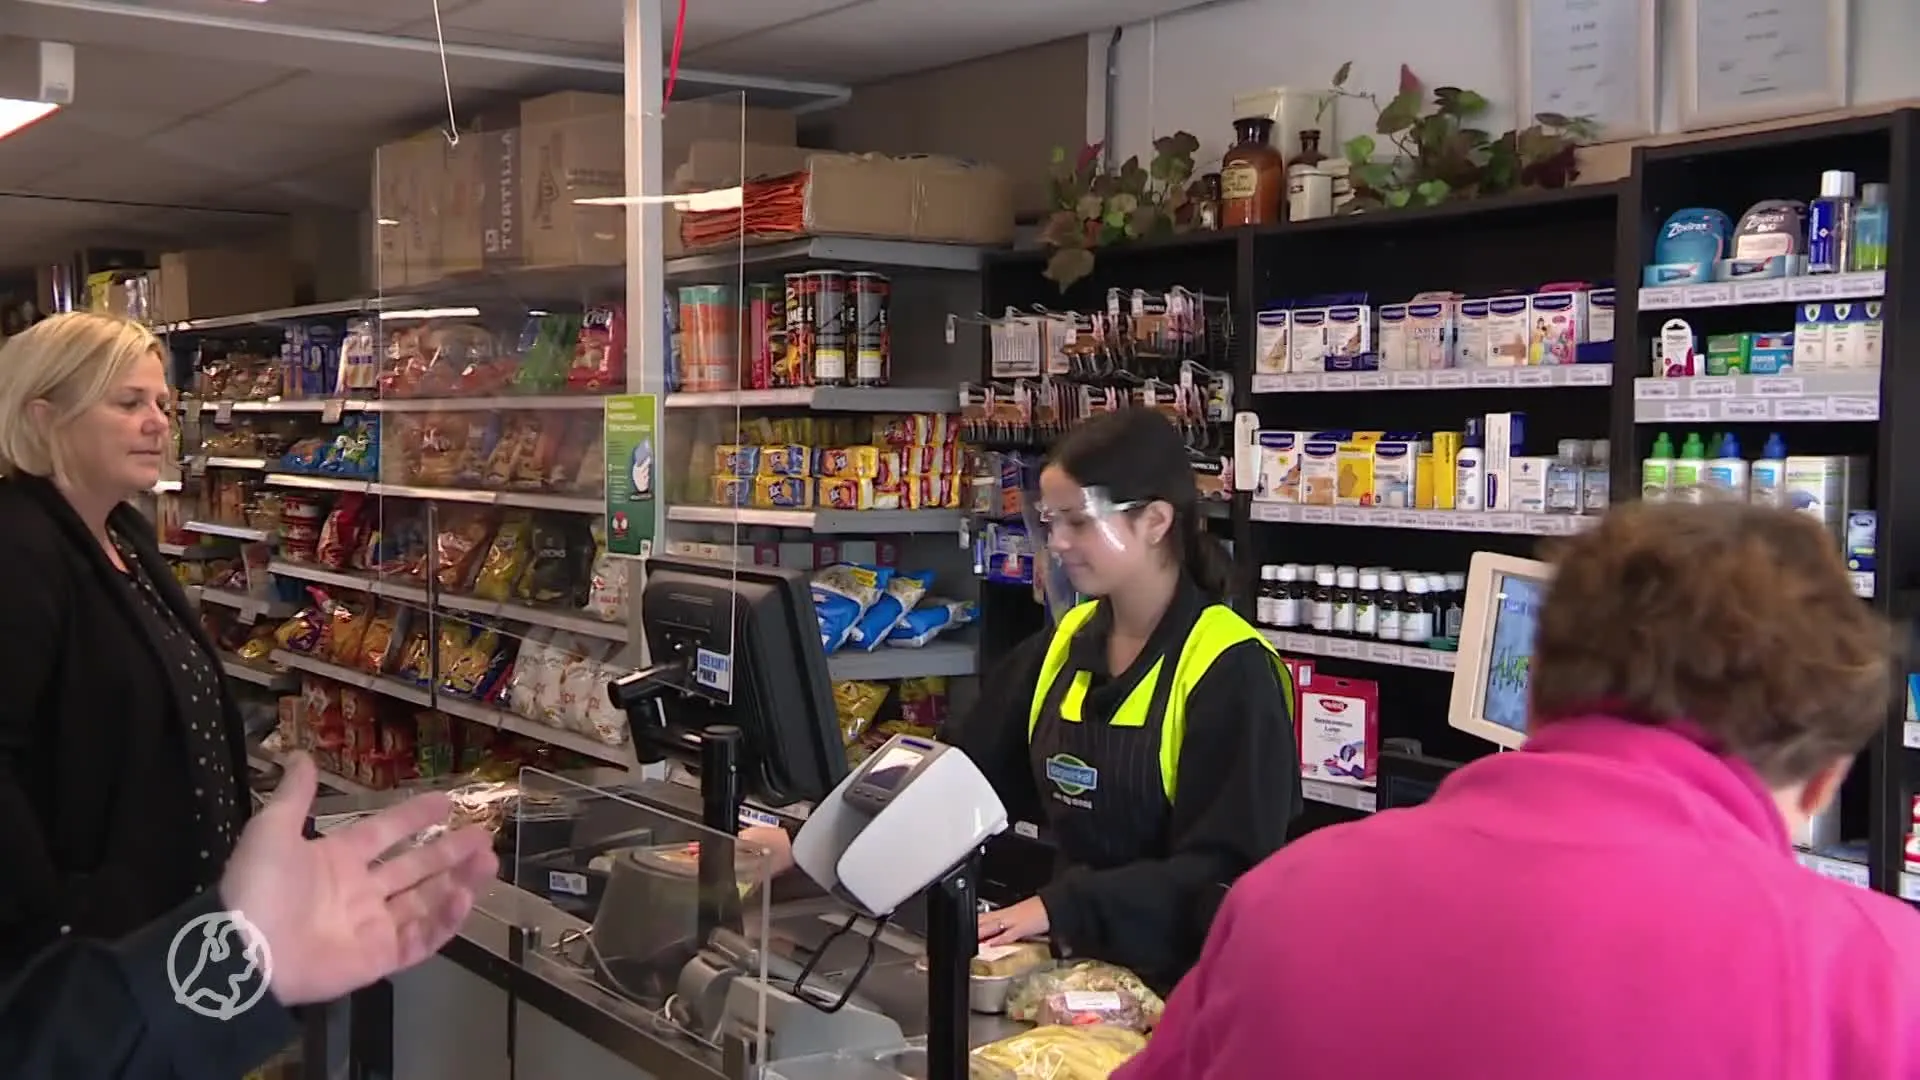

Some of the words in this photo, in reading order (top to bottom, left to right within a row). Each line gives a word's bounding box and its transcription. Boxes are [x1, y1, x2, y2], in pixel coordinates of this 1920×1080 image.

[500, 132, 513, 250] TORTILLA
[1666, 222, 1709, 239] Zovirax
[1744, 214, 1786, 230] Zovirax
